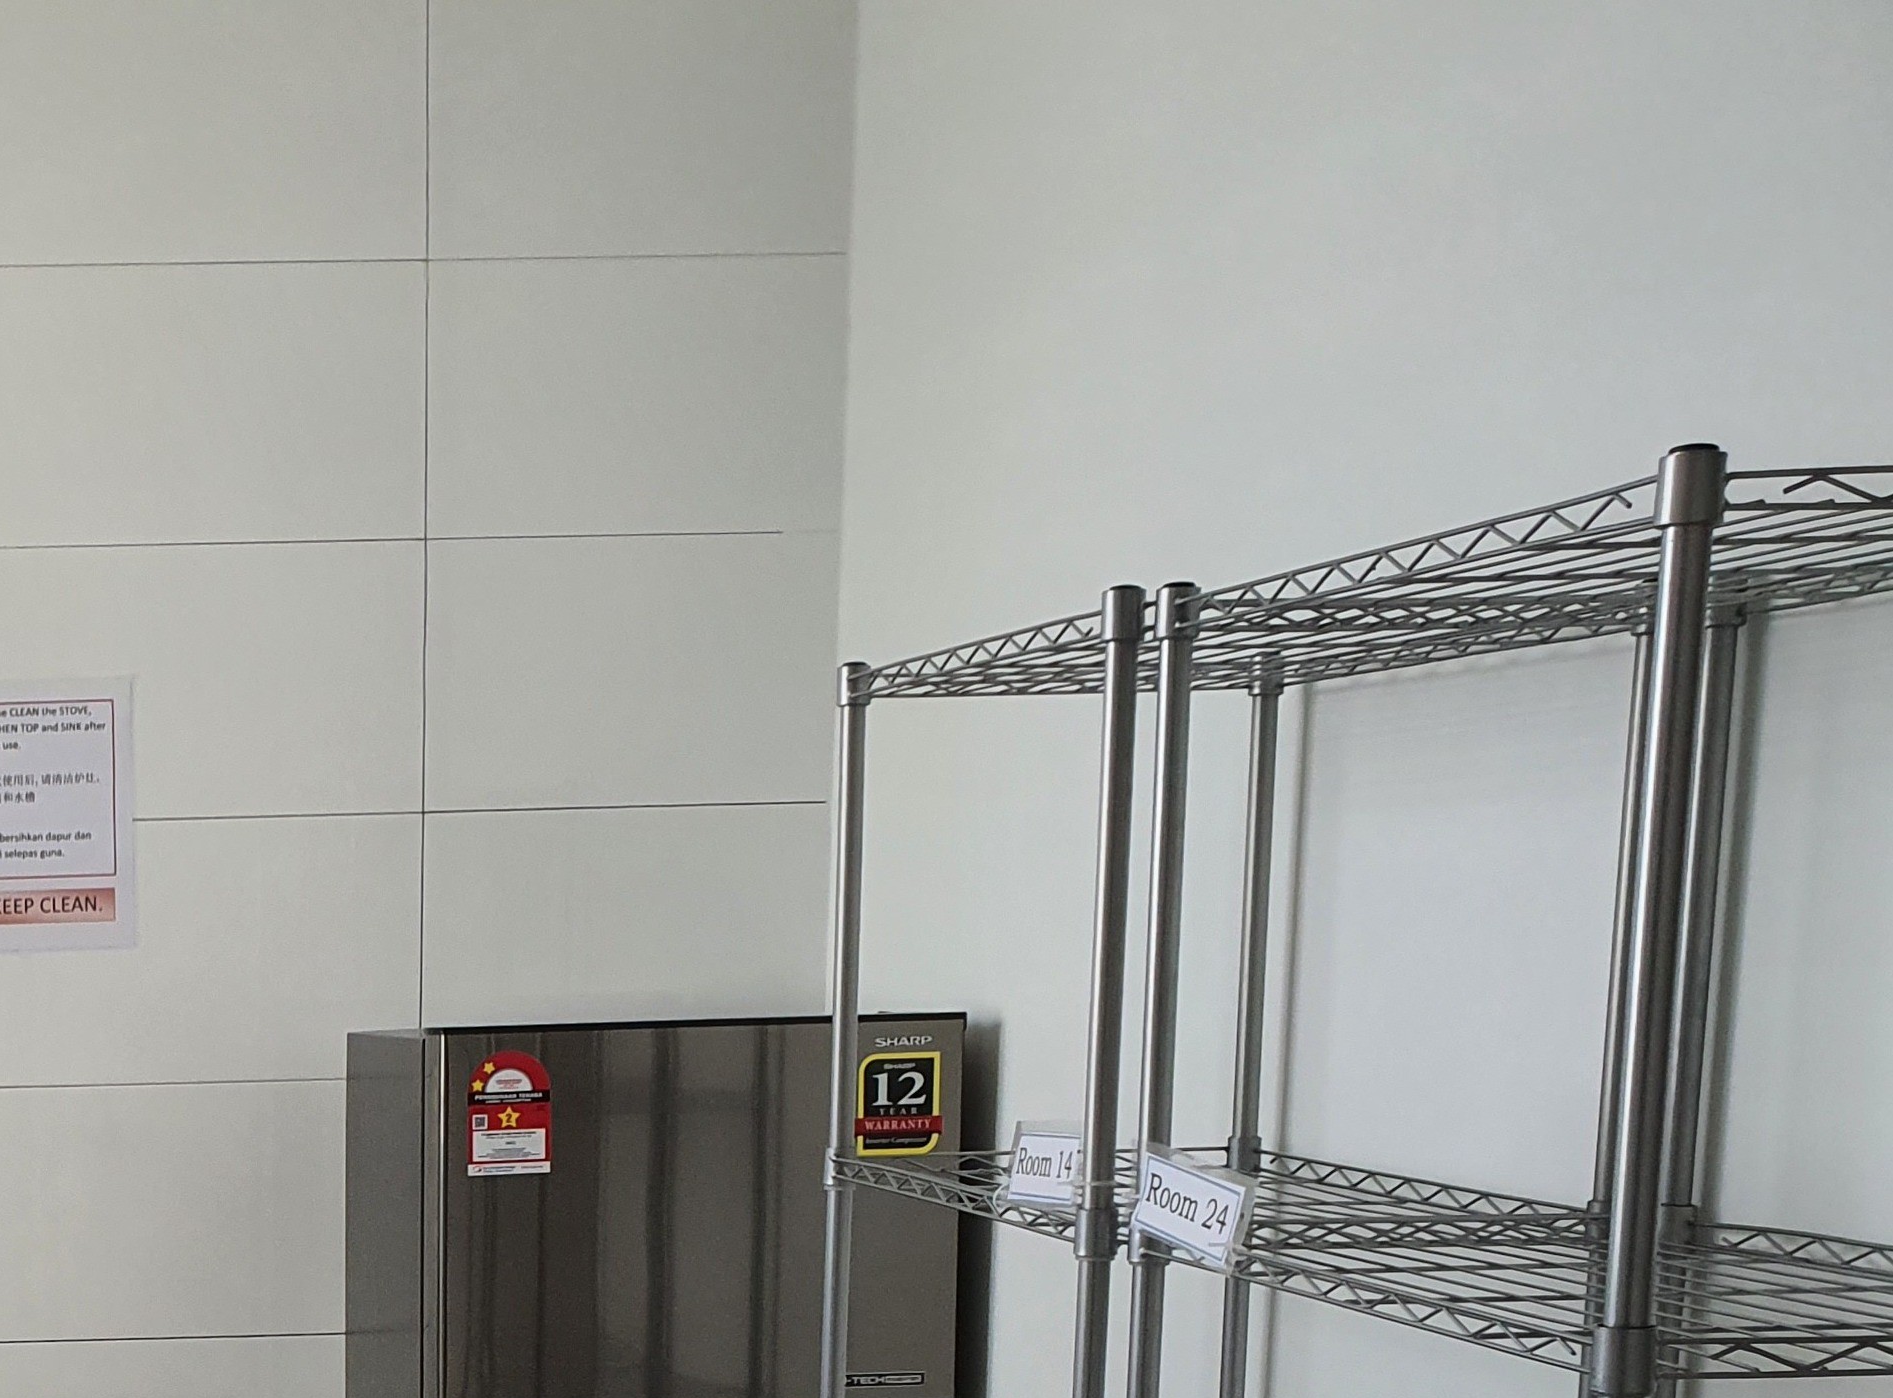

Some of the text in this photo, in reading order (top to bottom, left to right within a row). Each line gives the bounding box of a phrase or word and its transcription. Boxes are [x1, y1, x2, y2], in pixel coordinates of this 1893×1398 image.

[9, 707, 39, 717] CLEAN
[41, 707, 56, 716] the
[20, 723, 39, 733] TOP
[41, 723, 58, 732] and
[61, 722, 81, 731] SINK
[84, 721, 106, 731] after
[2, 742, 21, 750] use.
[0, 833, 43, 843] bersihkan
[45, 832, 72, 843] dapur
[74, 831, 92, 840] dan
[4, 850, 38, 860] selepas
[40, 849, 65, 860] guna.
[39, 895, 103, 913] CLEAN.
[874, 1036, 933, 1048] SHARP
[872, 1071, 927, 1106] 12
[879, 1107, 918, 1116] YEAR
[505, 1113, 513, 1124] 2
[865, 1119, 932, 1131] WARRANTY
[1015, 1147, 1073, 1179] Room 14
[1145, 1173, 1230, 1235] Room 24
[845, 1376, 884, 1385] -TECH
